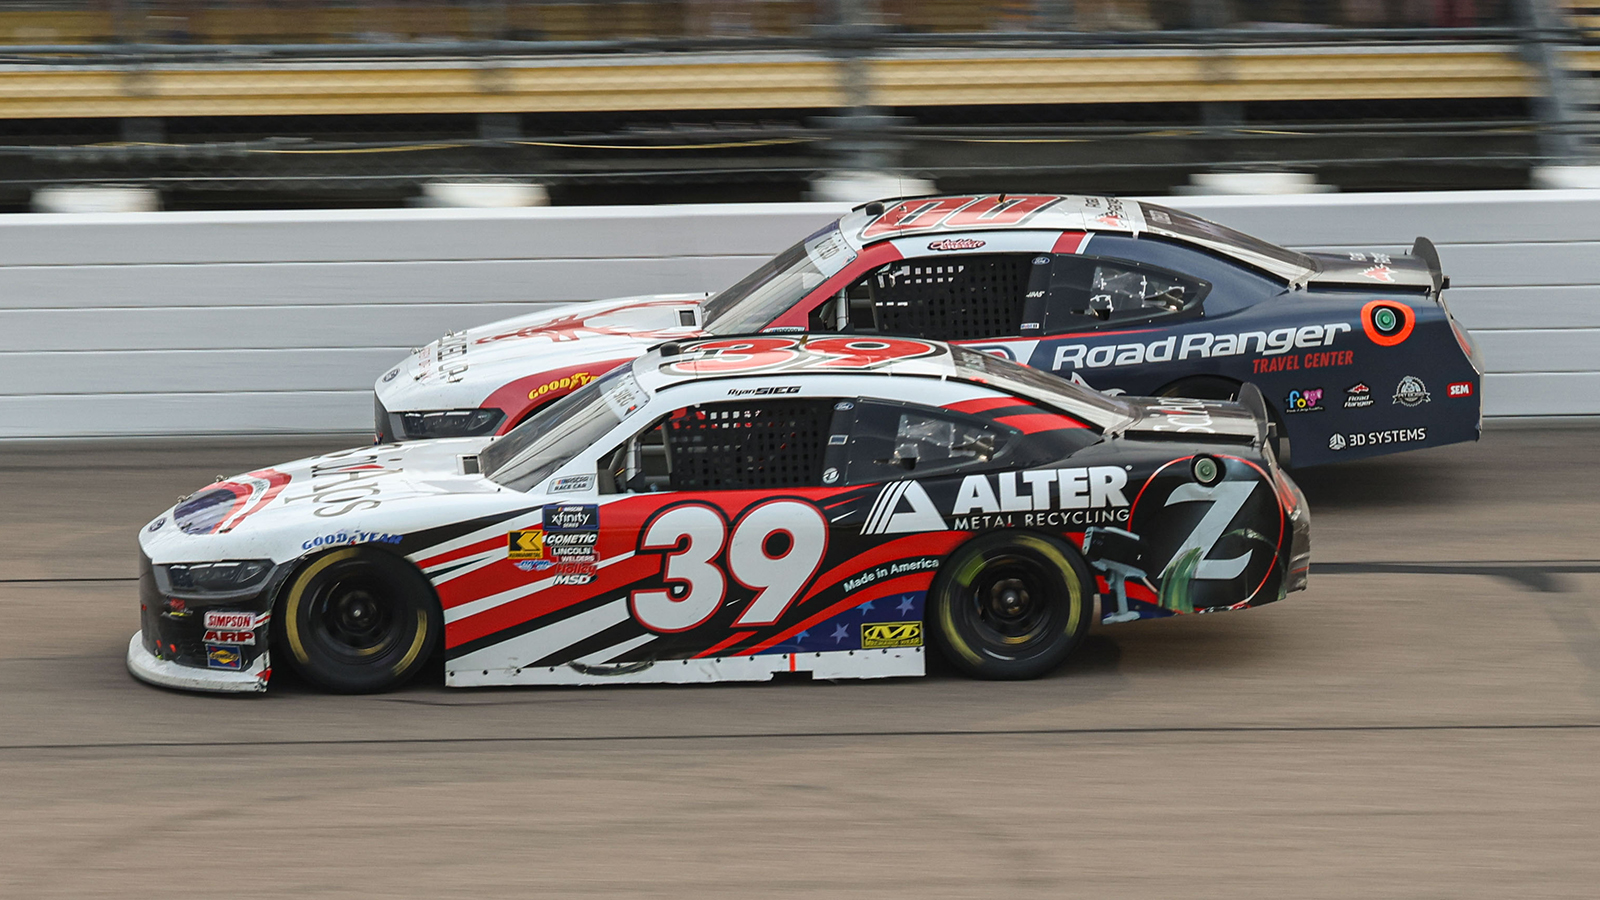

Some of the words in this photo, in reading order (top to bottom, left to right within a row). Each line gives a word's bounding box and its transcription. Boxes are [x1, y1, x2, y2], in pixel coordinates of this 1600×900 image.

[1052, 336, 1177, 371] Road
[1178, 323, 1352, 360] Ranger
[660, 337, 947, 376] 39
[1253, 355, 1300, 374] TRAVEL
[1304, 350, 1354, 369] CENTER
[727, 388, 755, 396] Ryan
[754, 386, 802, 395] SIEG
[1450, 384, 1470, 396] SEM
[1349, 434, 1366, 446] 3D
[1368, 428, 1427, 444] SYSTEMS
[952, 465, 1131, 515] ALTER
[551, 511, 591, 526] xfinity
[954, 514, 1016, 531] METAL
[1025, 509, 1131, 527] RECYCLING
[302, 529, 404, 550] GOODYEAR
[546, 533, 597, 545] COMETIC
[553, 547, 591, 555] LINCOLN
[556, 563, 598, 577] Holley
[630, 497, 829, 633] 39
[554, 575, 591, 585] MSD
[843, 573, 875, 592] Made
[876, 567, 888, 578] in
[890, 558, 940, 575] America
[207, 615, 251, 627] SIMPSON
[204, 631, 255, 642] ARP
